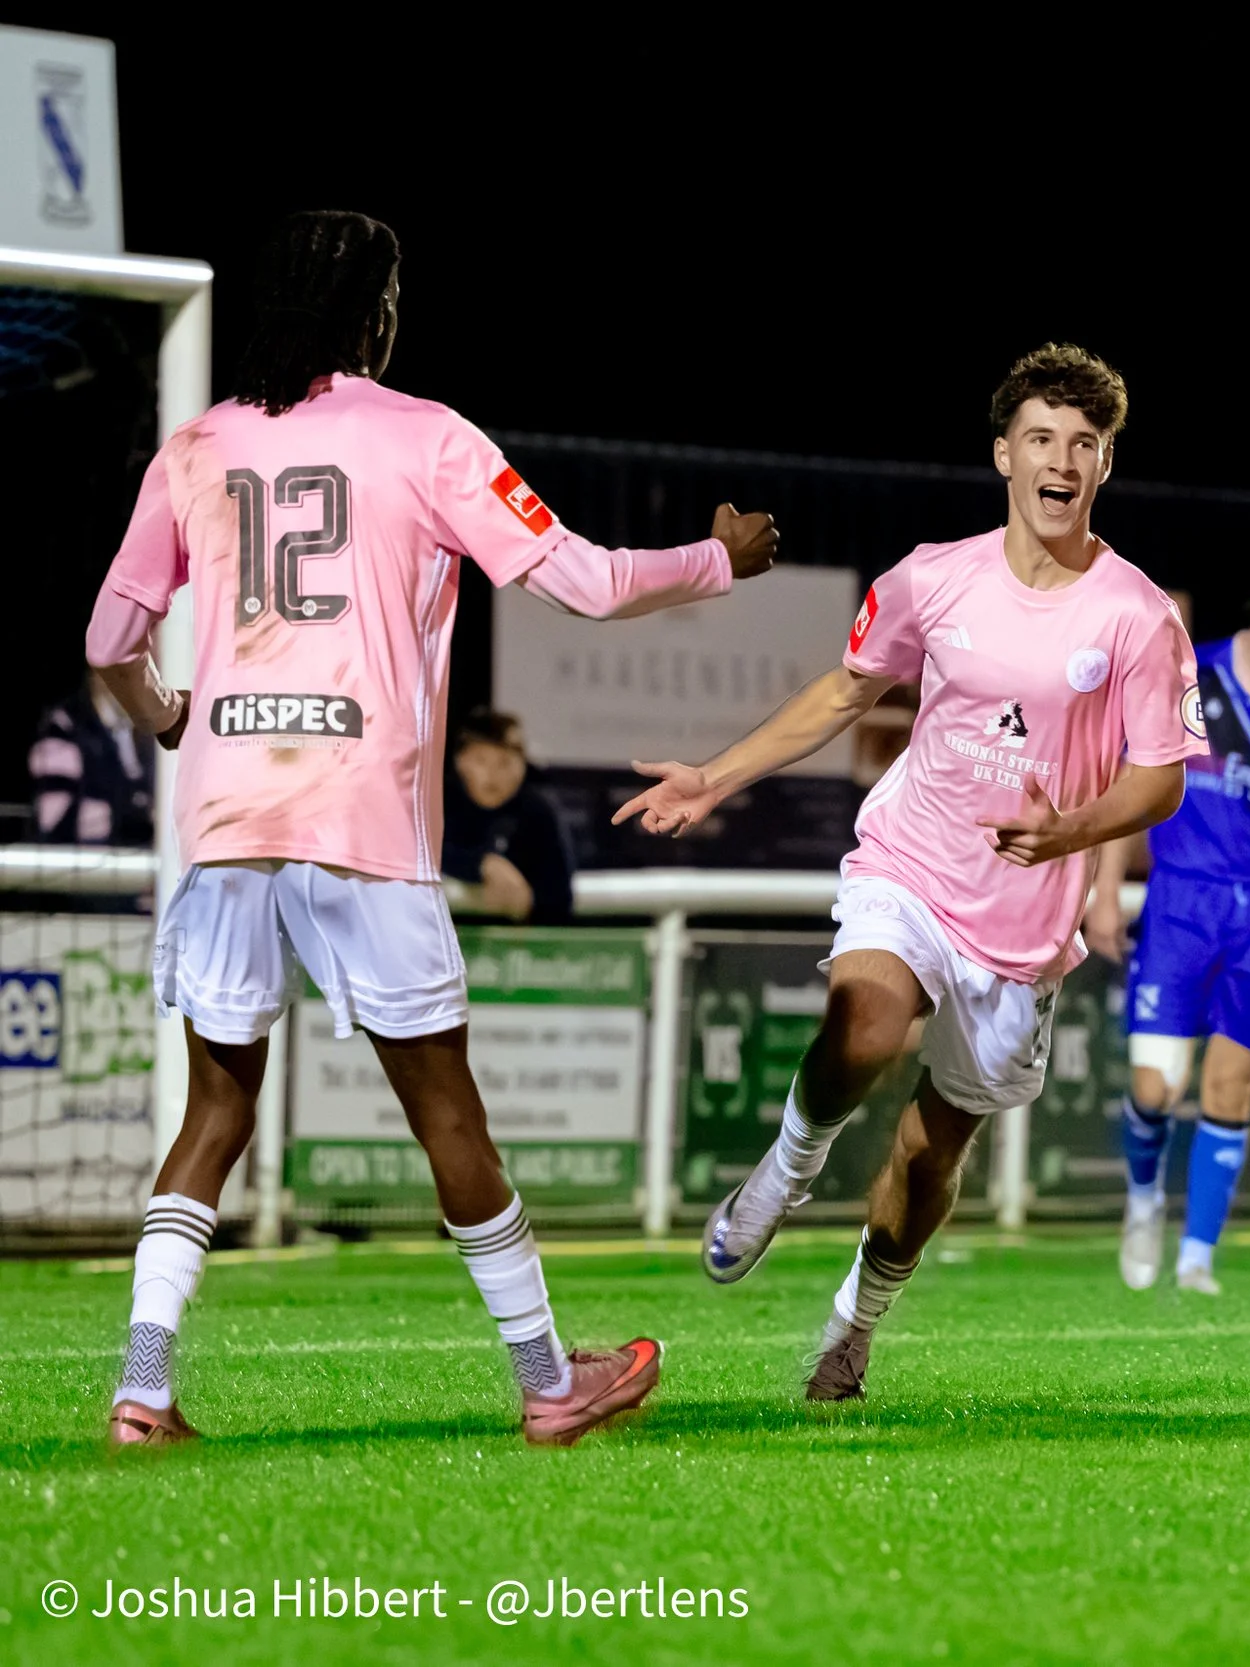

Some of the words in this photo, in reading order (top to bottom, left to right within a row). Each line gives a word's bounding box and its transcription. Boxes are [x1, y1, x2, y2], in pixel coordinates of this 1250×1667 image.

[226, 465, 352, 627] 12
[220, 694, 347, 735] HiSPEC
[944, 731, 1005, 765] REGIONAL
[974, 763, 994, 782] UK
